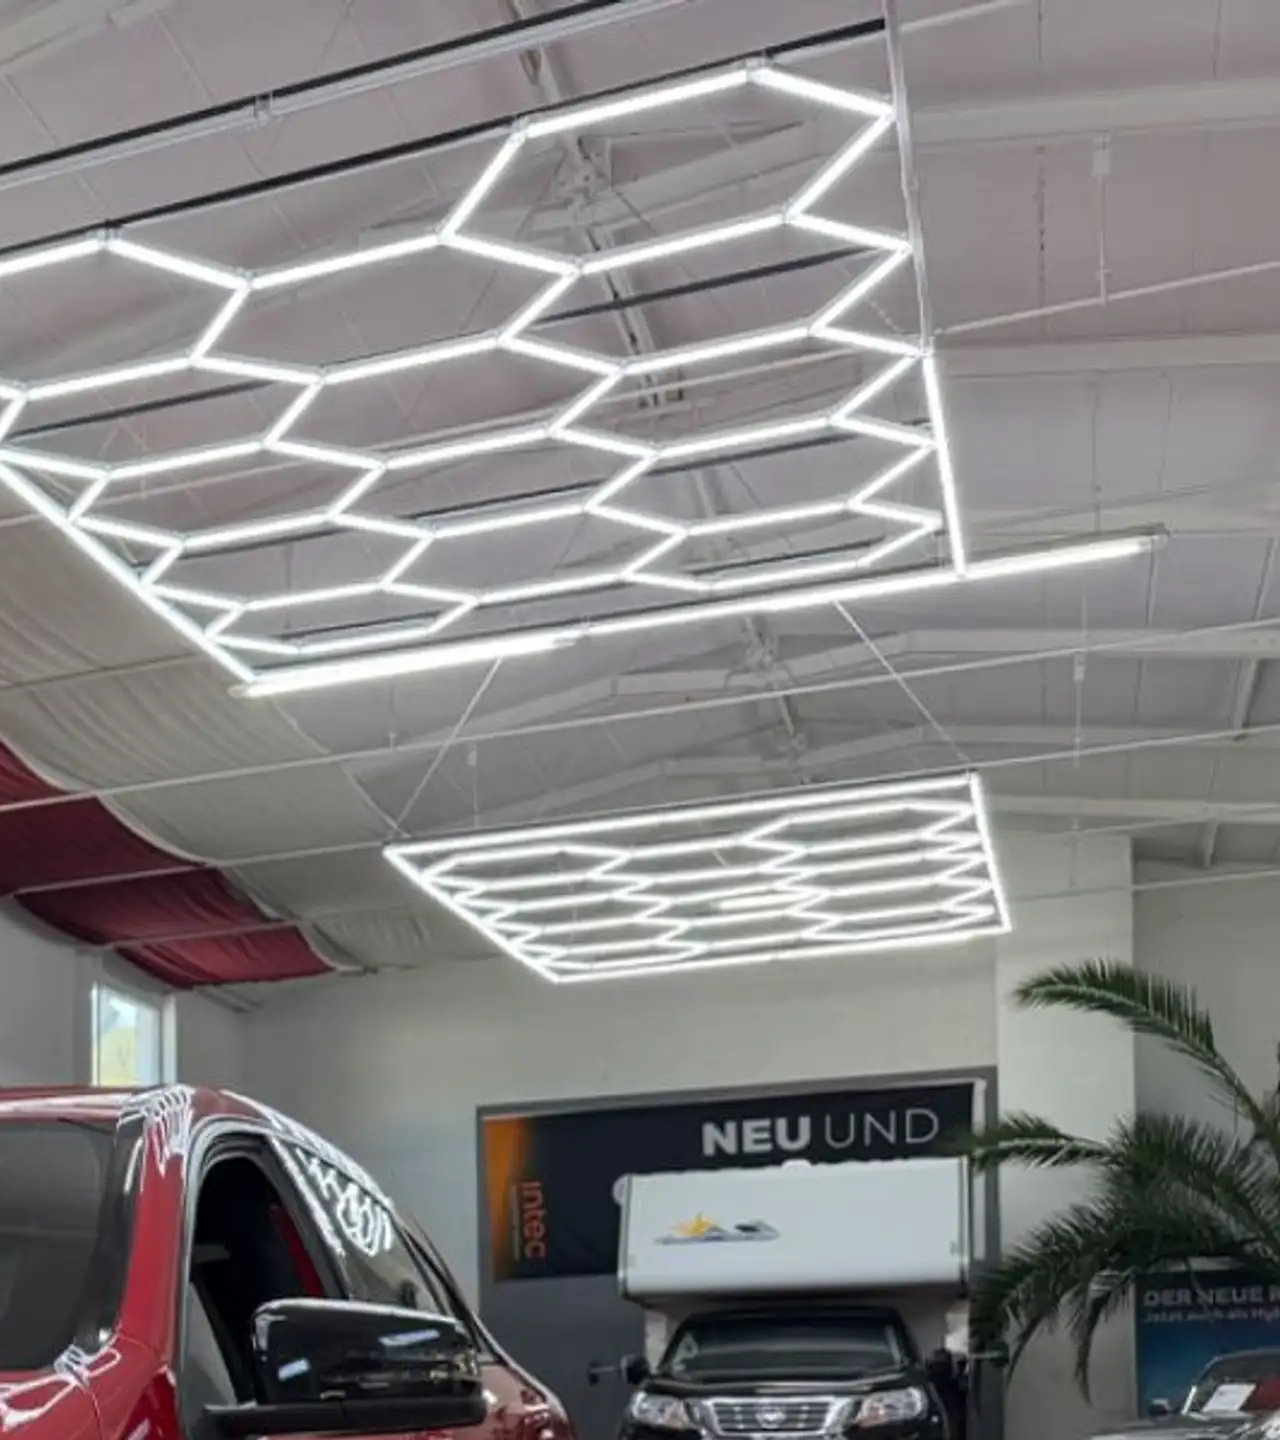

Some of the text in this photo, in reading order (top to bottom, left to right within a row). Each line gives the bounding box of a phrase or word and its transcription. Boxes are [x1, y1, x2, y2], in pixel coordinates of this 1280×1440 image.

[702, 1107, 940, 1157] NEU UND
[521, 1180, 548, 1259] intec
[1143, 1287, 1193, 1307] DER
